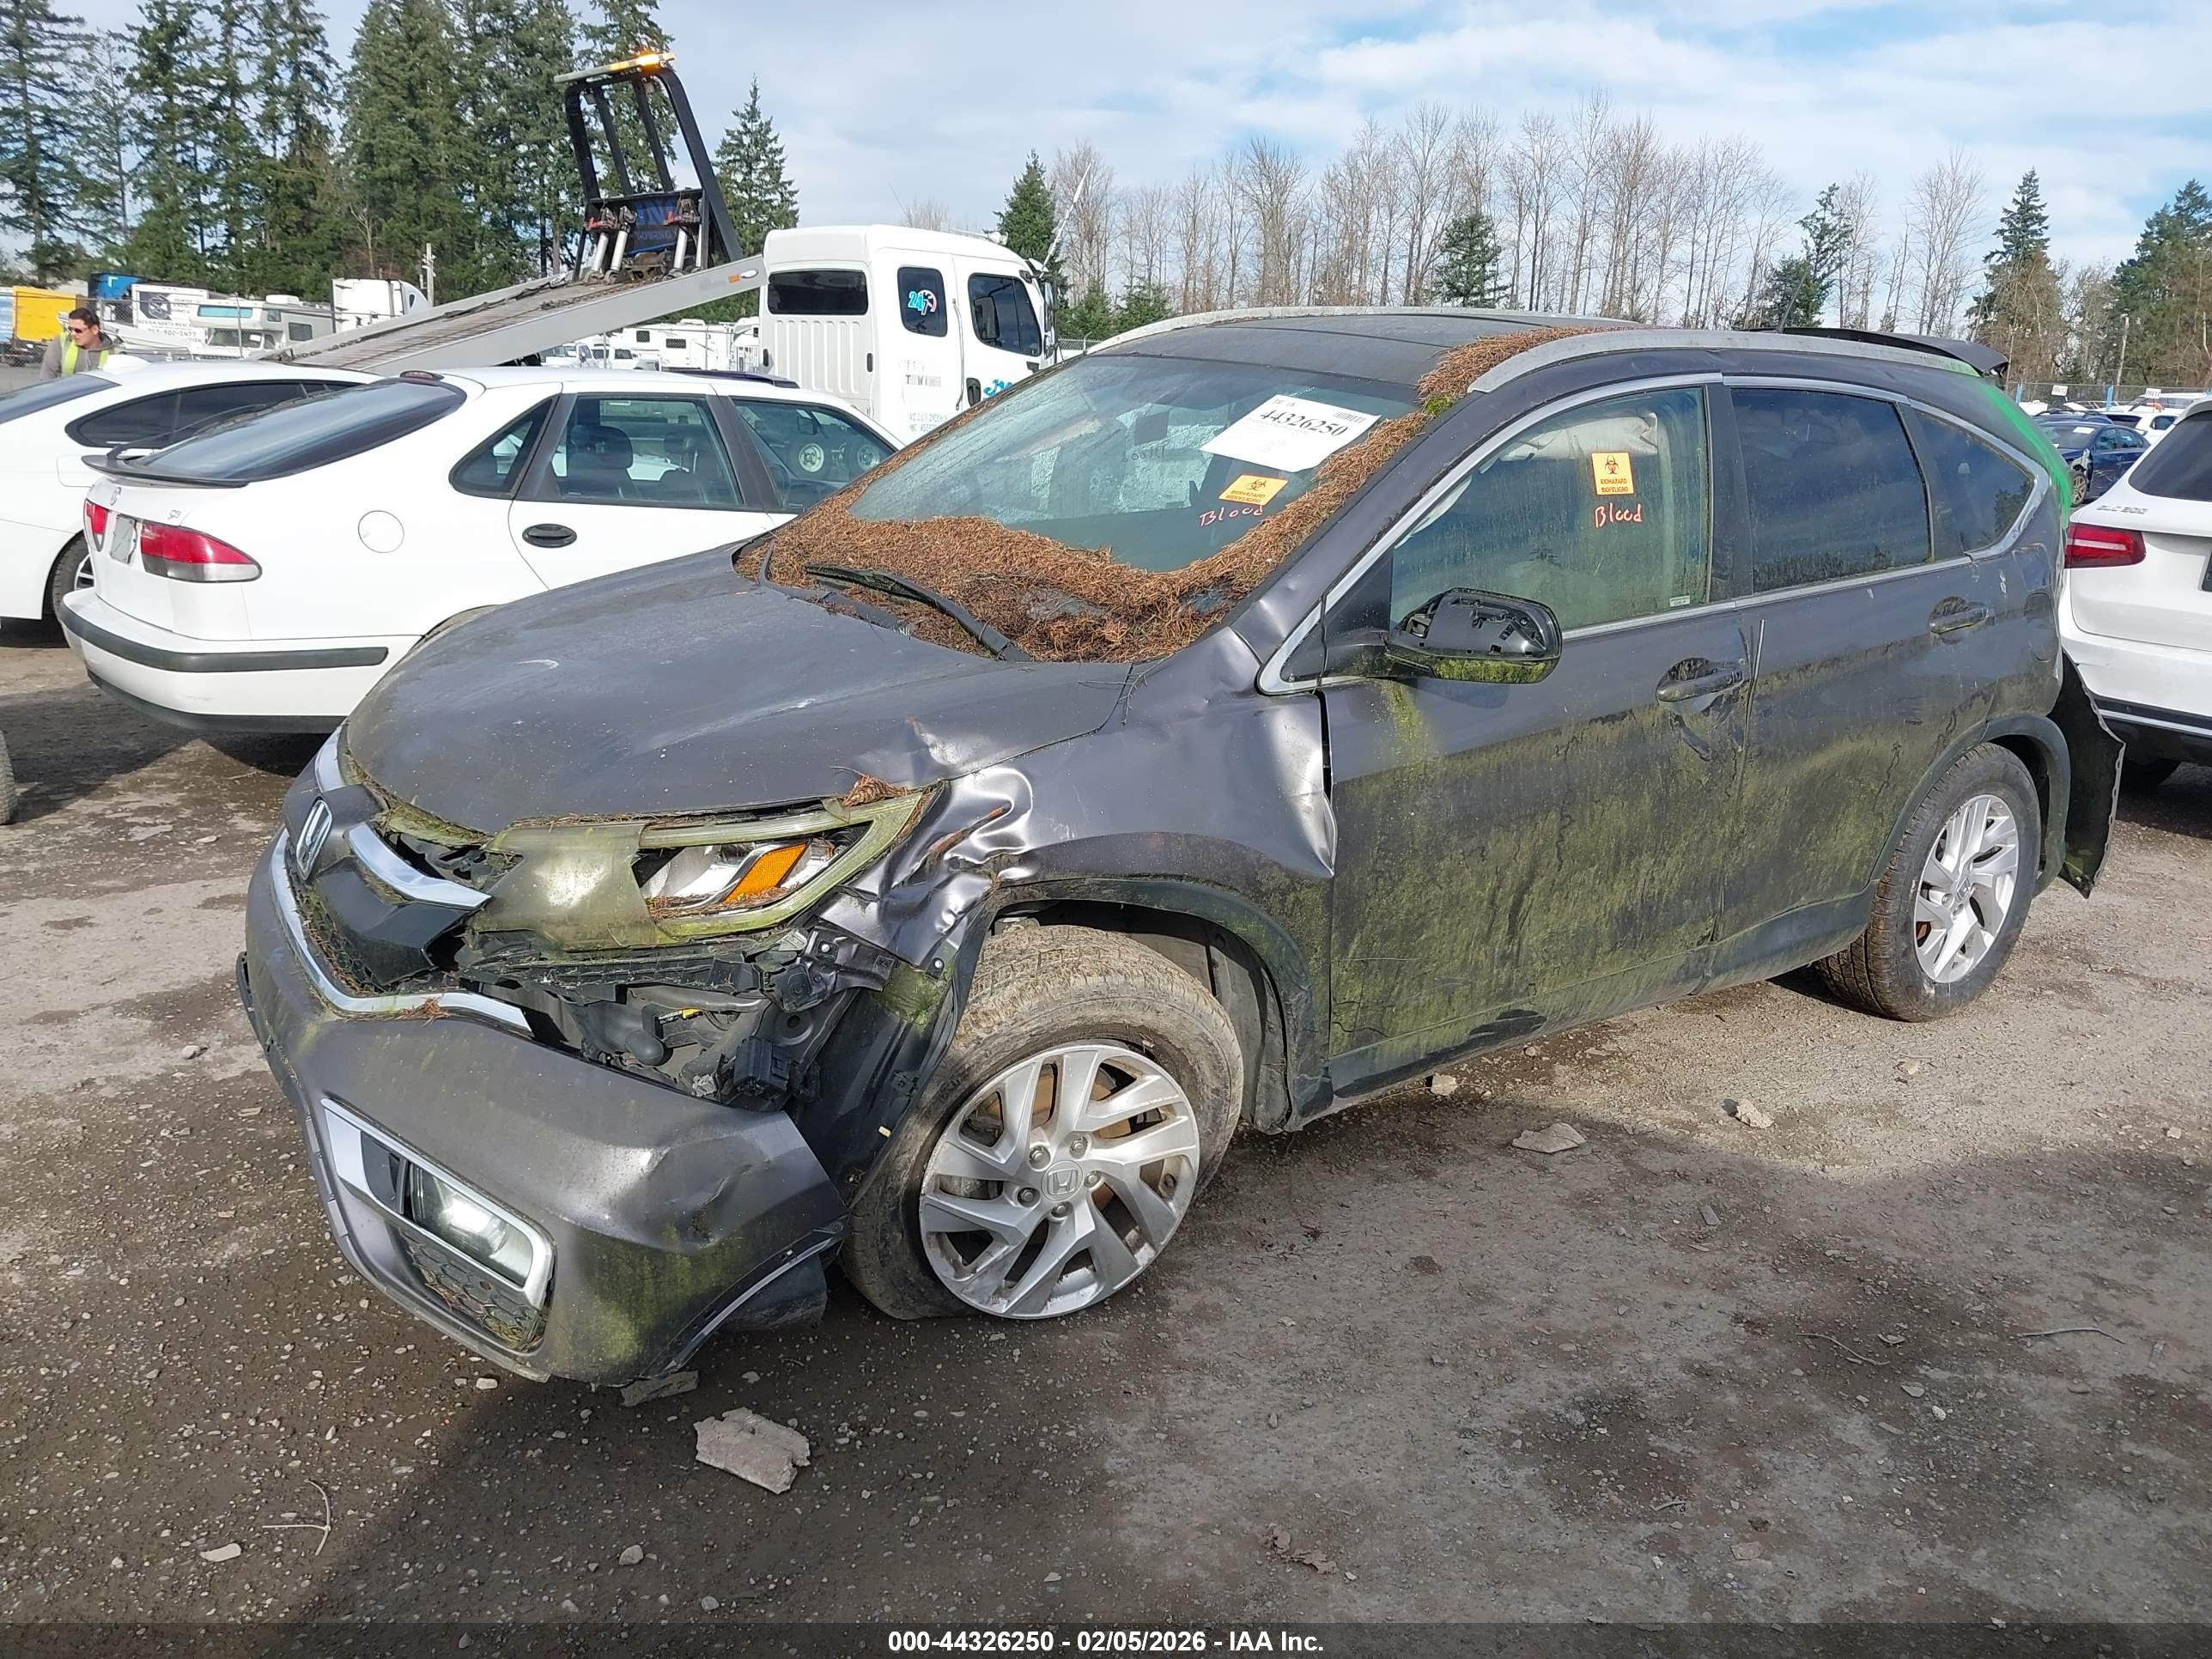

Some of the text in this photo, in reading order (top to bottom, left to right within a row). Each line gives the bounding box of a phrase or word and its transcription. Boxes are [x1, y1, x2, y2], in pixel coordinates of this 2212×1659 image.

[1260, 409, 1348, 437] 44326250
[1231, 489, 1266, 499] BIOHAZARD
[1199, 505, 1264, 526] Blood
[1595, 502, 1644, 528] Blood
